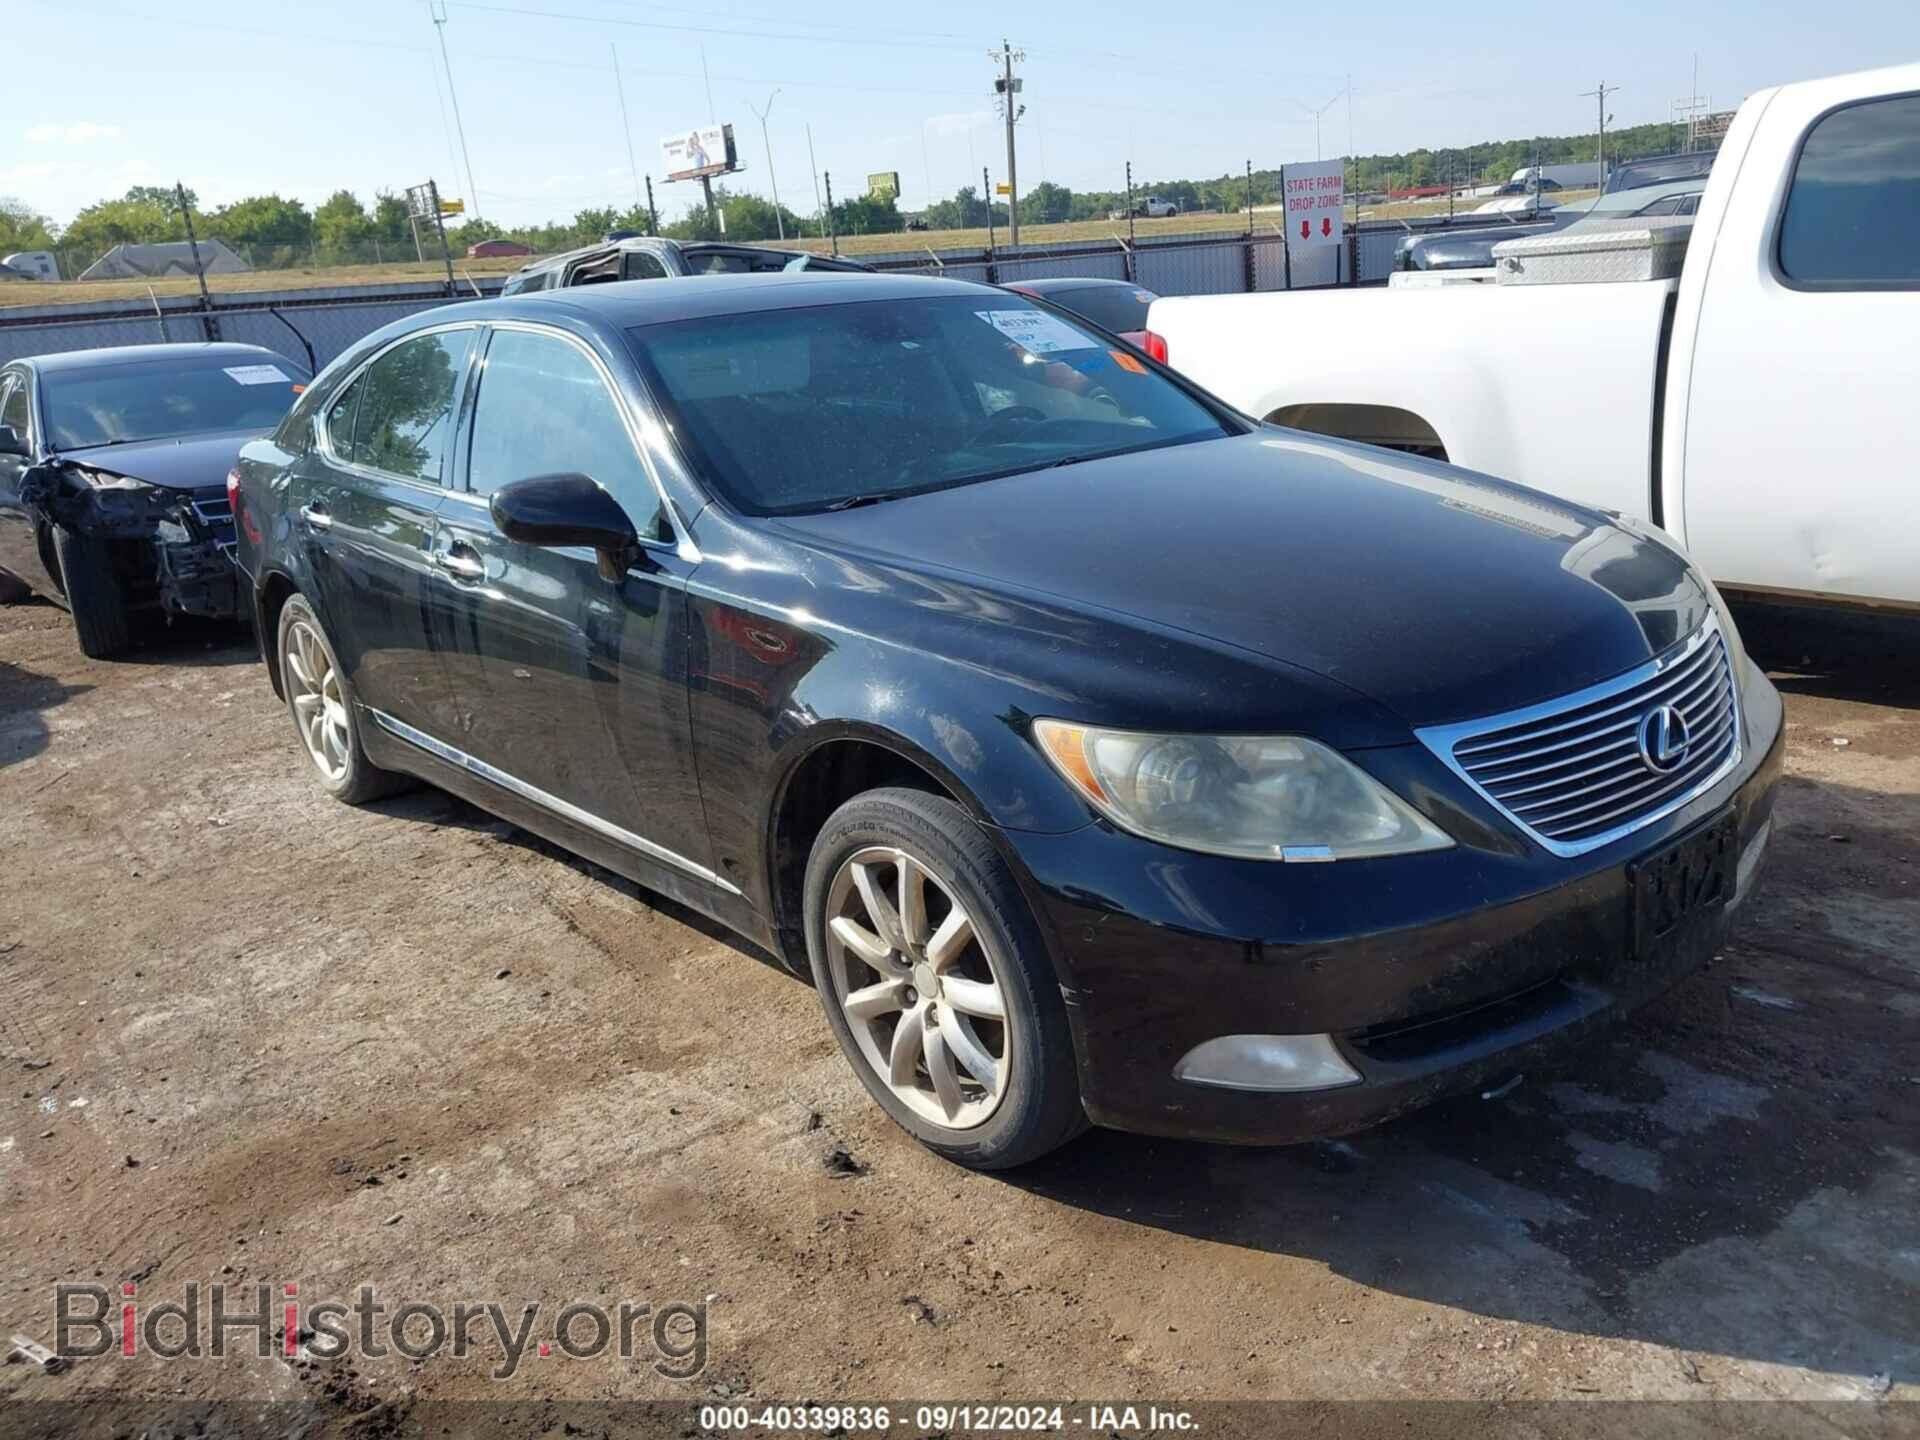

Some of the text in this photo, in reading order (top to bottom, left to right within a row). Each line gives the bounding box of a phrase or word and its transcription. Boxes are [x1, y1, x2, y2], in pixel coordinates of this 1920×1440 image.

[1286, 176, 1342, 193] STATE FARM
[1289, 194, 1341, 211] DROP ZONE
